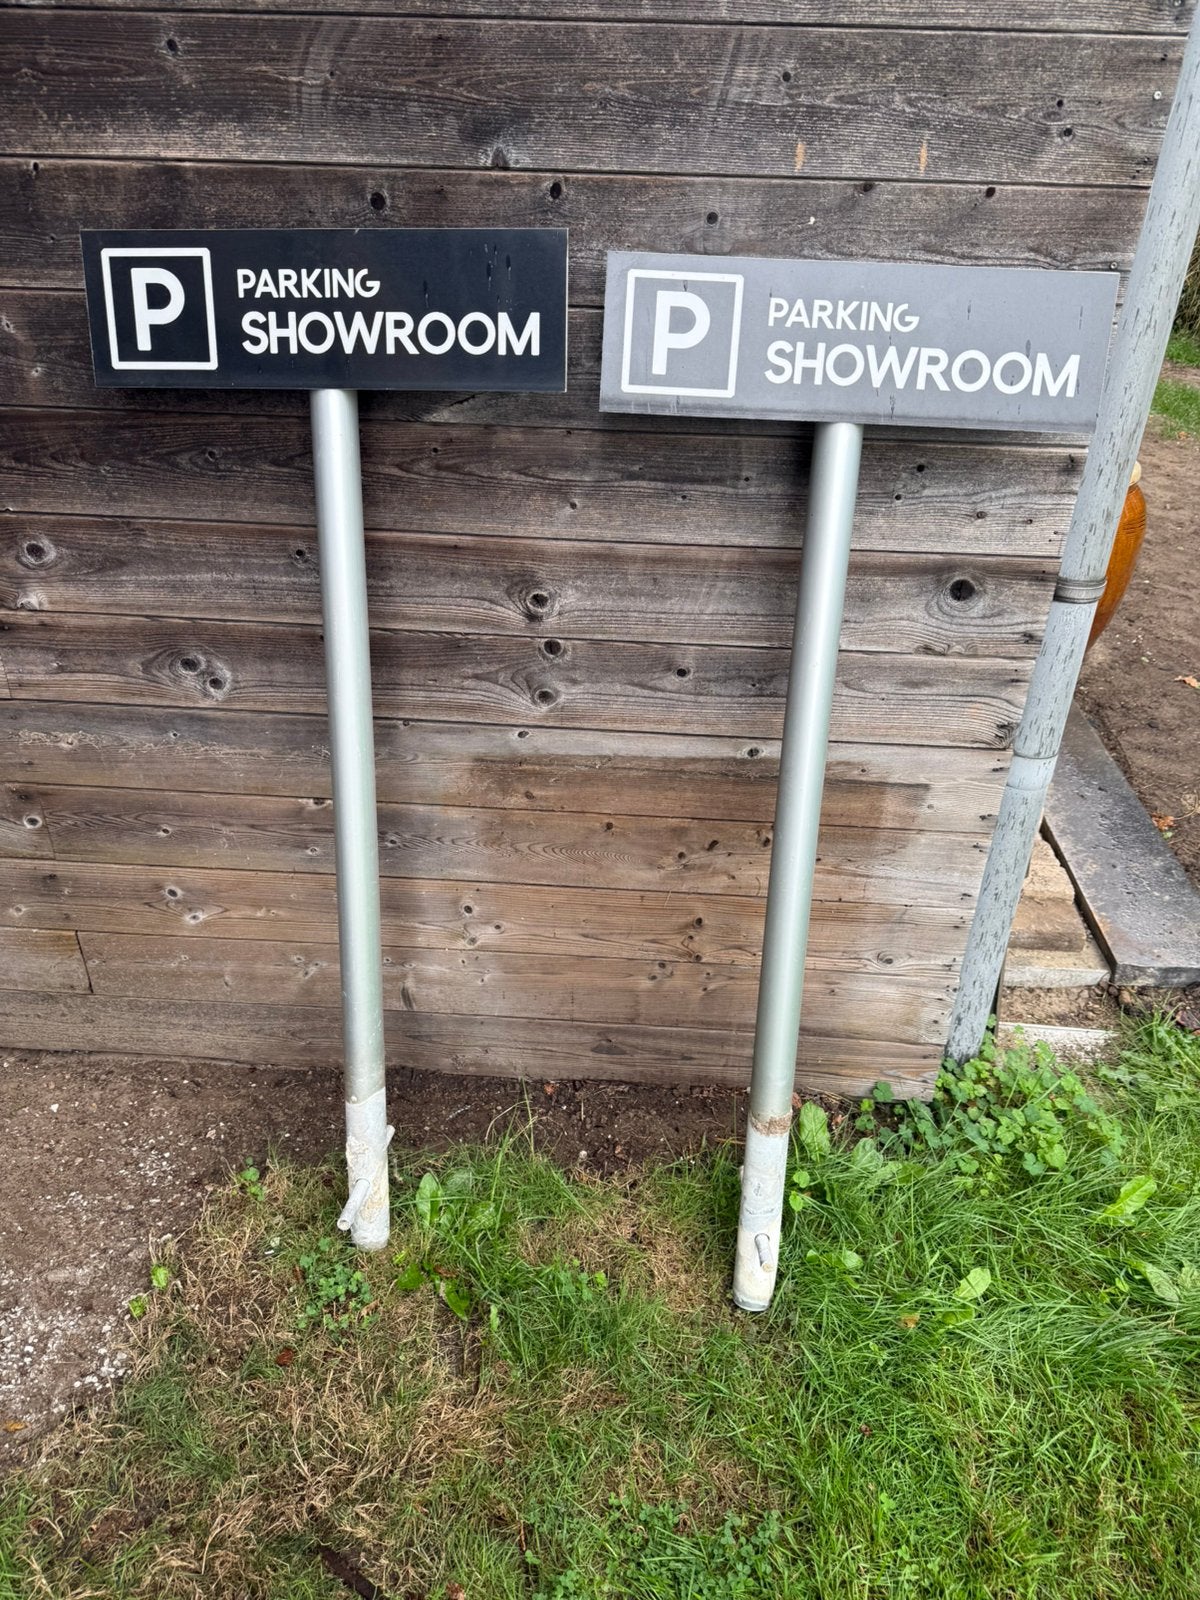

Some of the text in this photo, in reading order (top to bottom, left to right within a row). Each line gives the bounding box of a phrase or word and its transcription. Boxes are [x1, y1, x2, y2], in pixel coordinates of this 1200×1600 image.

[131, 267, 185, 351] P
[236, 268, 381, 299] PARKING
[241, 311, 541, 356] SHOWROOM
[651, 289, 711, 376] P
[767, 296, 921, 333] PARKING
[764, 340, 1081, 398] SHOWROOM
